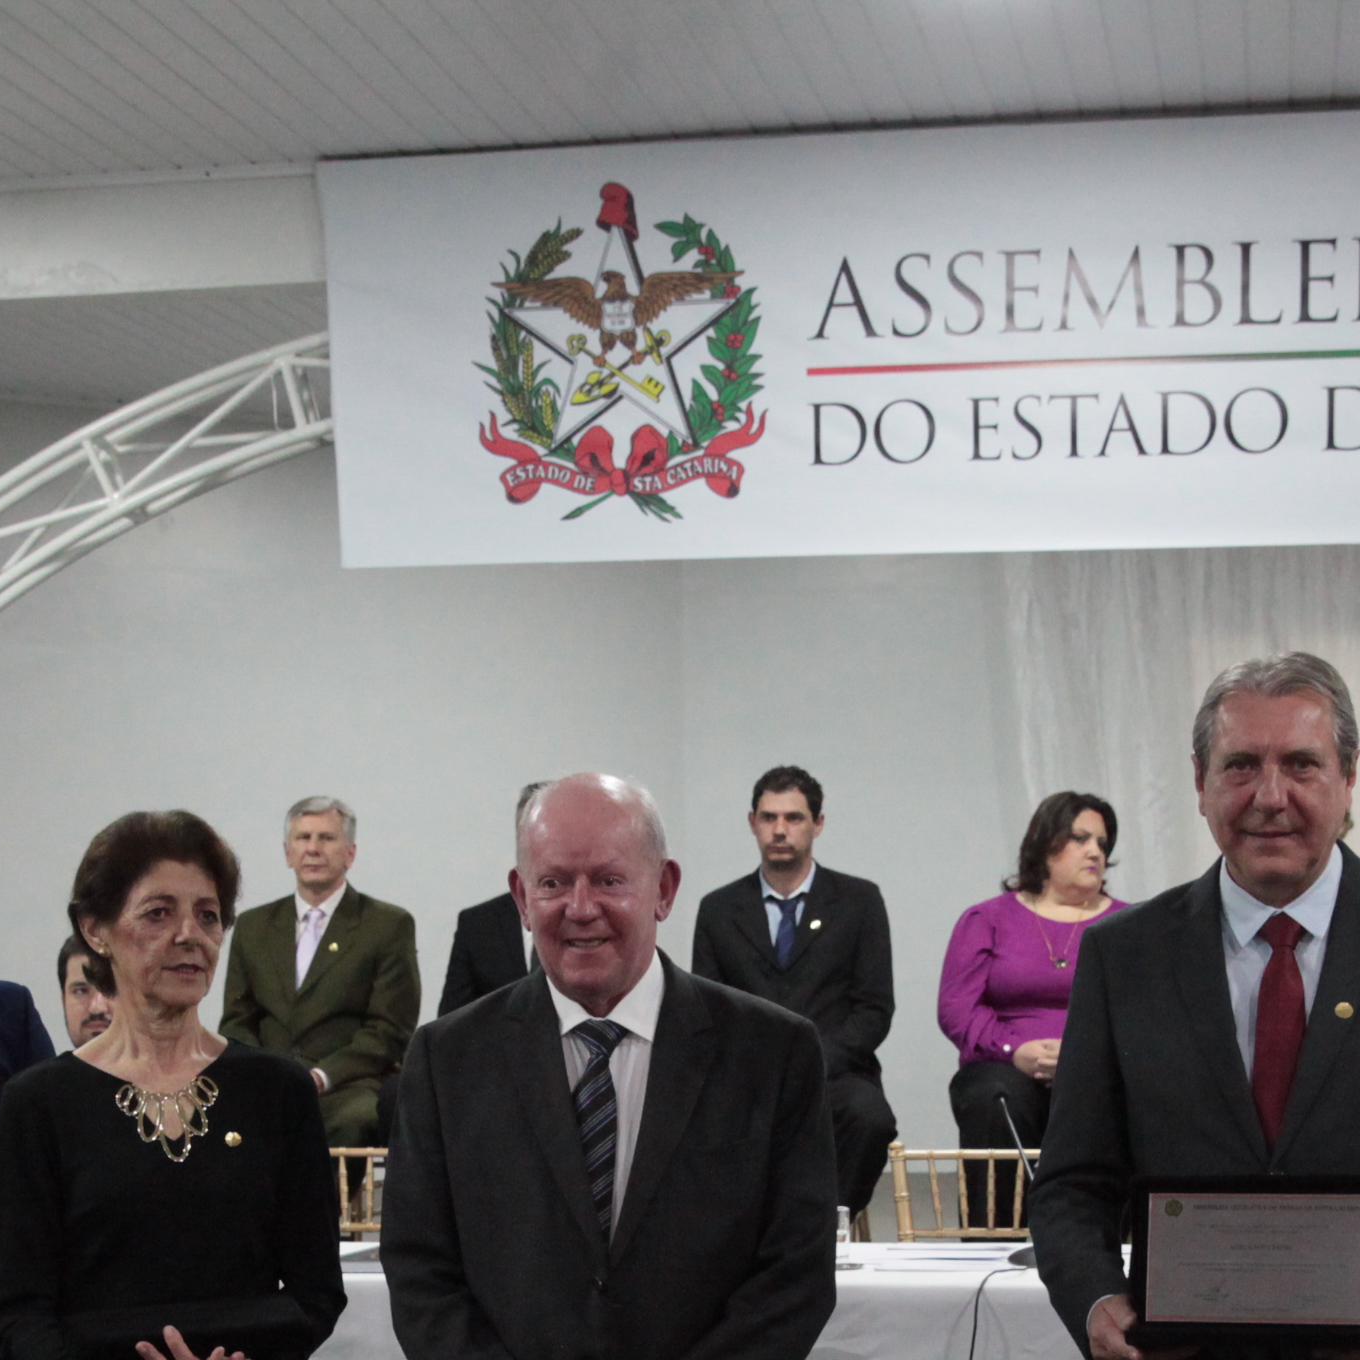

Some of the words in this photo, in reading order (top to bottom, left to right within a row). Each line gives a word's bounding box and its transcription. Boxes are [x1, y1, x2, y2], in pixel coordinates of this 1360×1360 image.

[808, 398, 937, 467] DO
[968, 386, 1290, 462] ESTADO
[505, 462, 572, 486] ESTADO
[573, 475, 596, 492] DE
[666, 456, 739, 485] CATARINA
